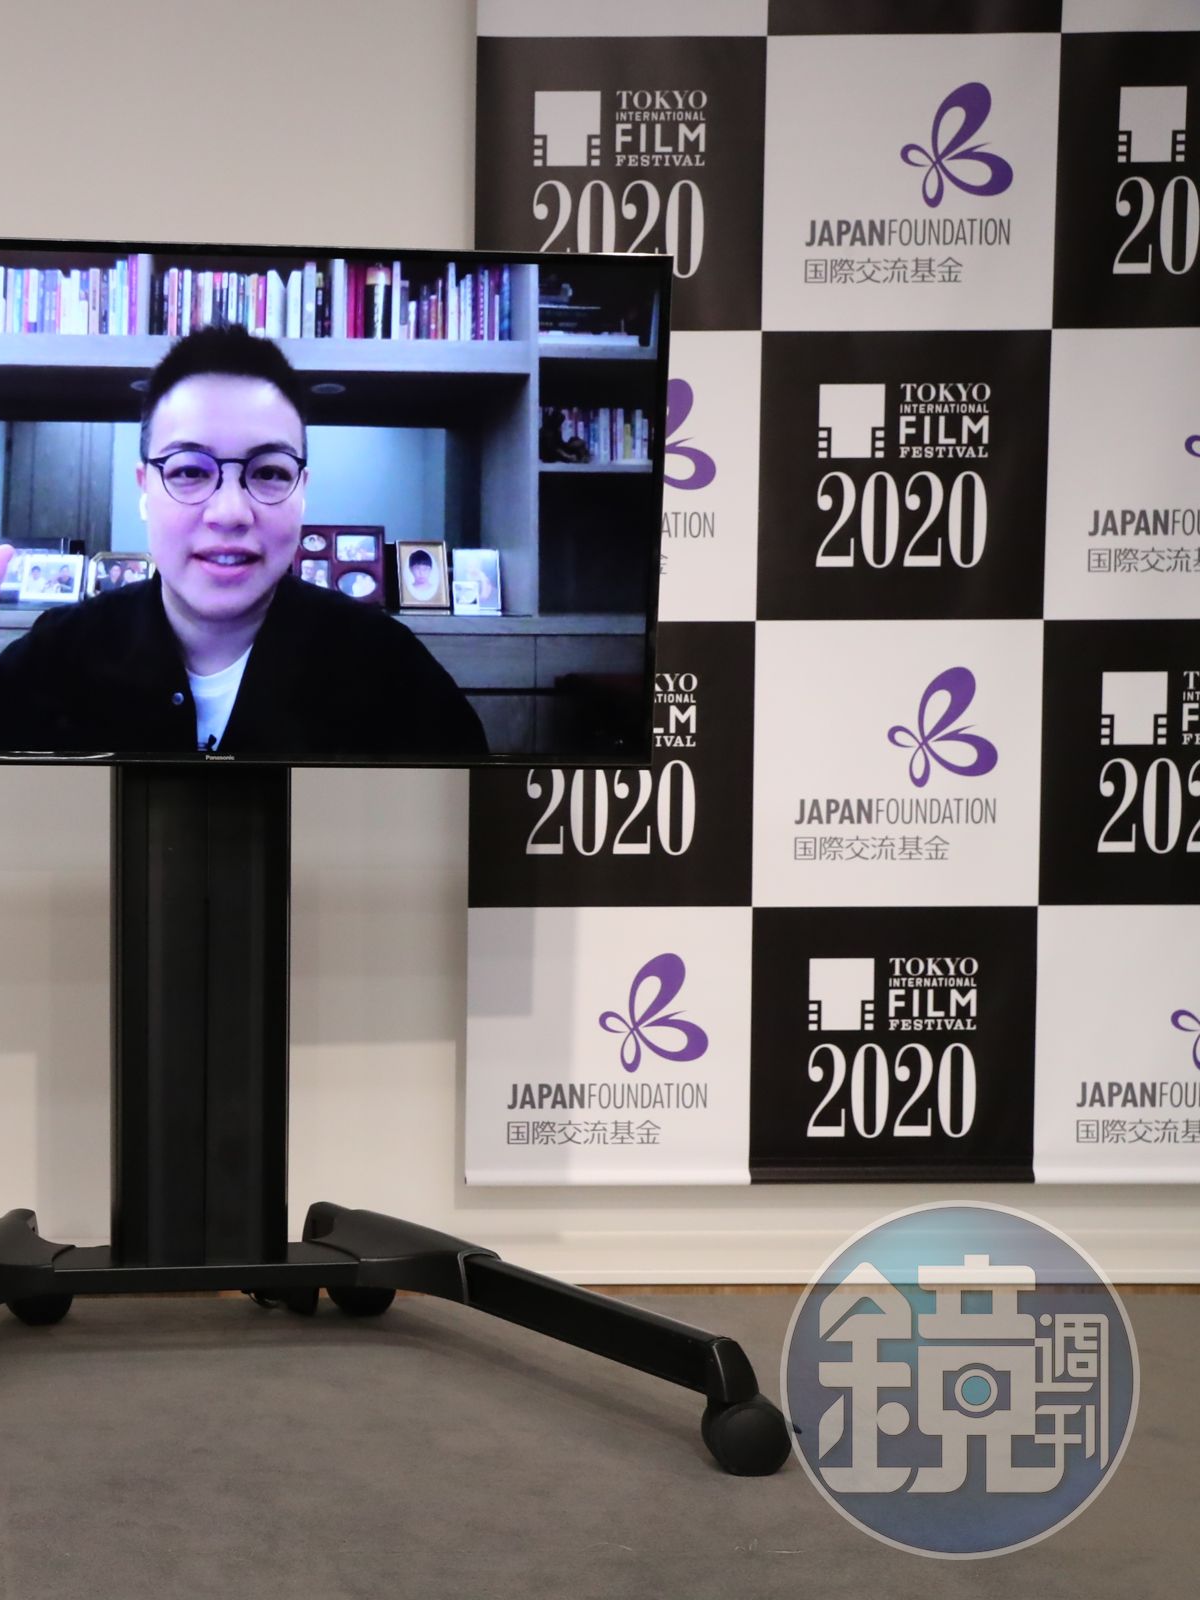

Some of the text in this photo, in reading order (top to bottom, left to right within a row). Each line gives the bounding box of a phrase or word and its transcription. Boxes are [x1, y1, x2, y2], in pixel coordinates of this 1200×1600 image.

[616, 90, 708, 110] TOKYO
[615, 110, 706, 122] INTERNATIONAL
[615, 123, 706, 152] FILM
[615, 154, 706, 167] FESTIVAL
[532, 179, 705, 279] 2020
[1112, 175, 1200, 275] 20
[803, 256, 964, 285] 国際交流基金
[900, 383, 991, 403] TOKYO
[899, 403, 989, 414] INTERNATIONAL
[899, 415, 990, 445] FILM
[899, 446, 989, 459] FESTIVAL
[815, 470, 988, 569] 2020
[1087, 546, 1200, 573] 国際交流
[526, 759, 696, 856] 2020
[793, 834, 951, 861] 国際交流基金
[889, 957, 979, 977] TOKYO
[888, 977, 977, 988] INTERNATIONAL
[888, 988, 977, 1017] FILM
[888, 1018, 977, 1031] FESTIVAL
[806, 1042, 977, 1139] 2020
[506, 1119, 661, 1146] 国際交流基金
[1075, 1117, 1200, 1144] 国際交流基
